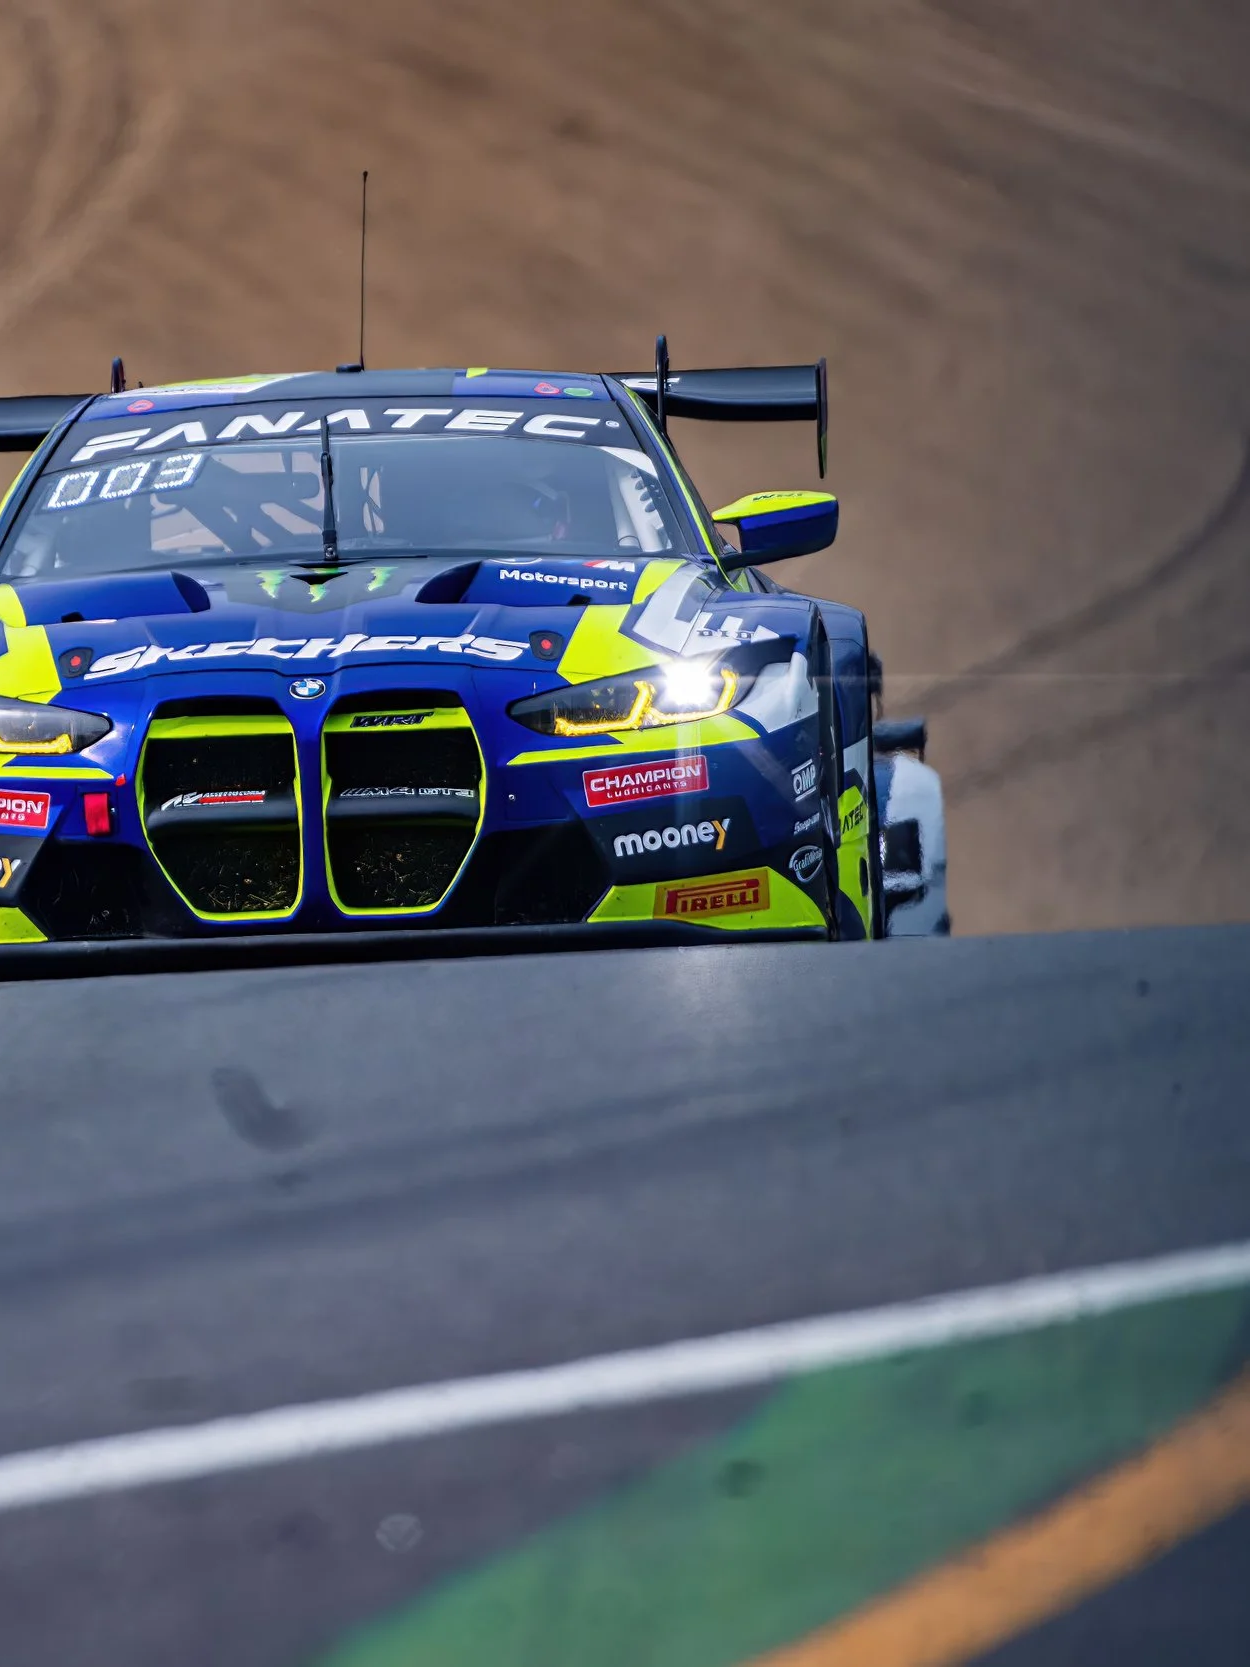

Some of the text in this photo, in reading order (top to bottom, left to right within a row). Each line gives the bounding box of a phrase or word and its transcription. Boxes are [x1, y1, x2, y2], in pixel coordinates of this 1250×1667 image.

[70, 408, 600, 462] FANATEC
[48, 453, 203, 509] 003
[500, 569, 628, 591] Motorsport
[83, 632, 530, 681] SKECHERS
[589, 764, 702, 792] CHAMPION
[606, 780, 688, 799] LUBRICANTS
[792, 764, 817, 796] OMP
[613, 818, 731, 857] mooney
[664, 878, 760, 915] PIRELLI
